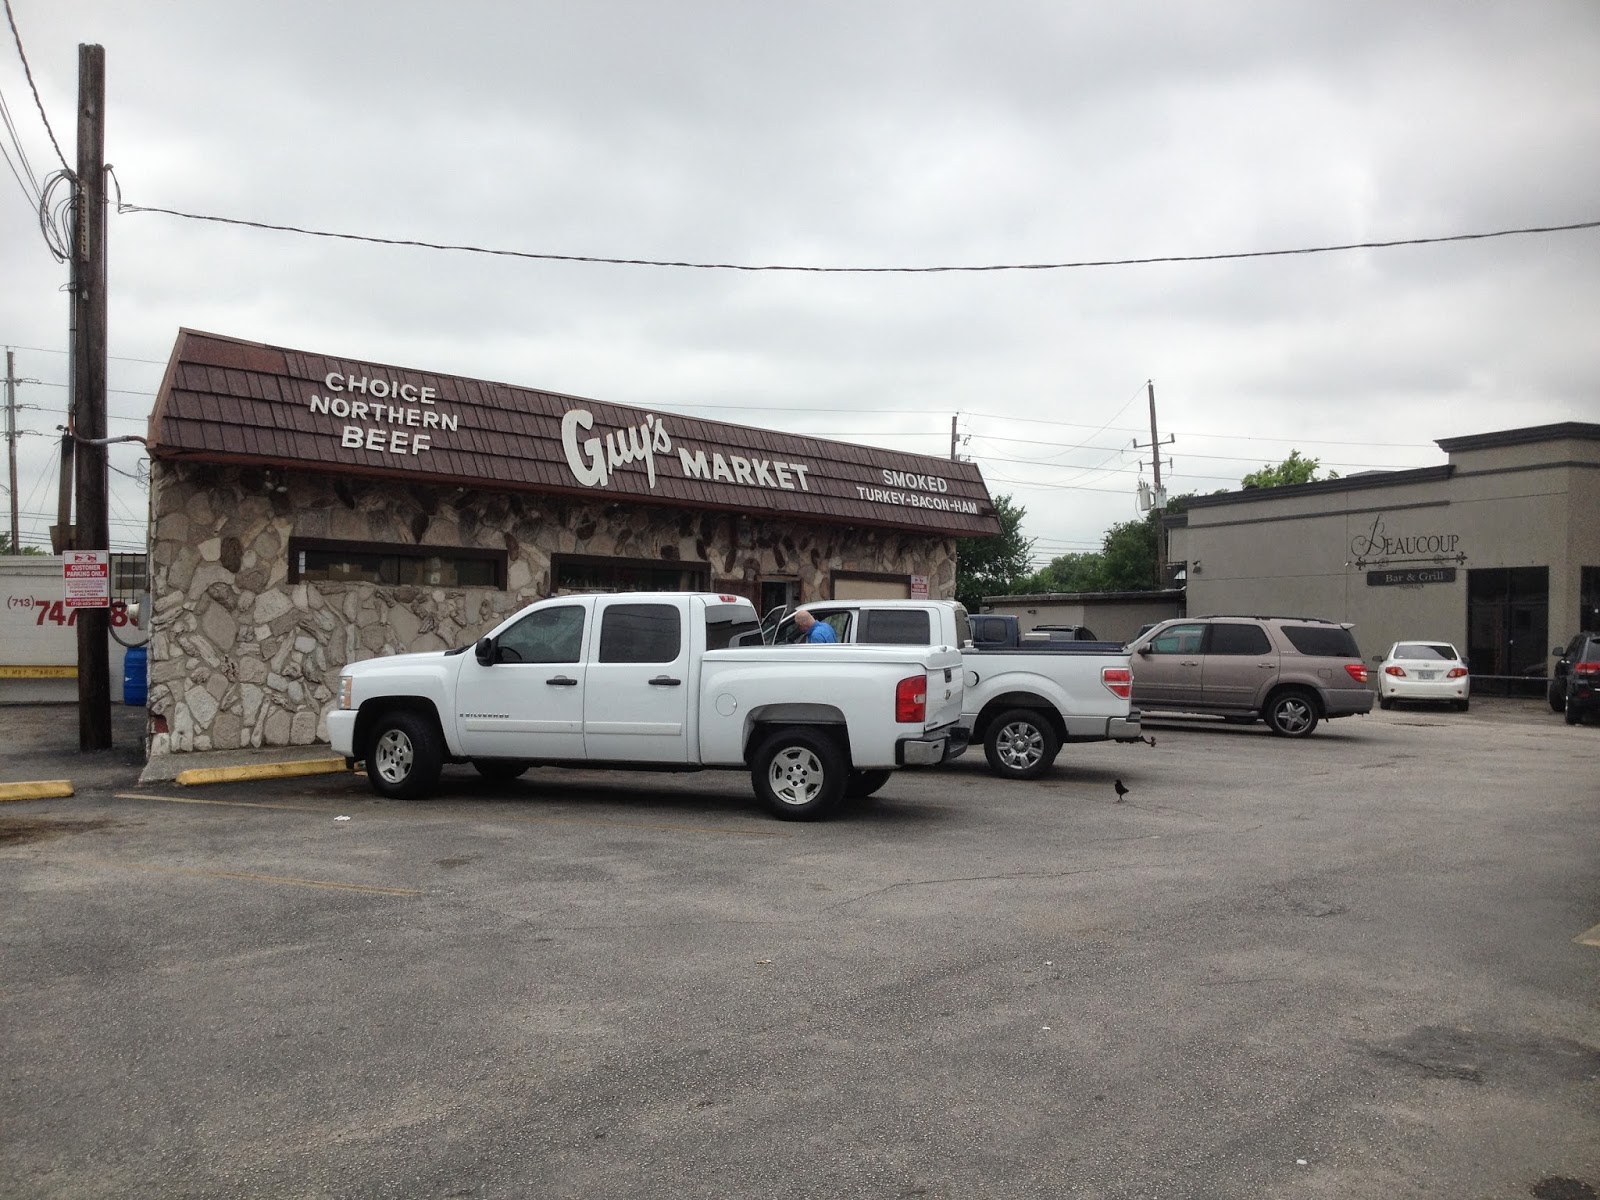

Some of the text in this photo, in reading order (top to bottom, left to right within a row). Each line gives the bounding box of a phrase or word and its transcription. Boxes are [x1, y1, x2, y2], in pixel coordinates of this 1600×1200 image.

[325, 372, 436, 405] CHOICE
[310, 395, 458, 432] NORTHERN
[341, 425, 431, 455] BEEF
[561, 409, 809, 491] Guy's MARKET
[882, 469, 948, 493] SMOKED
[1385, 571, 1444, 583] Bar & Grill
[7, 595, 35, 610] (713)
